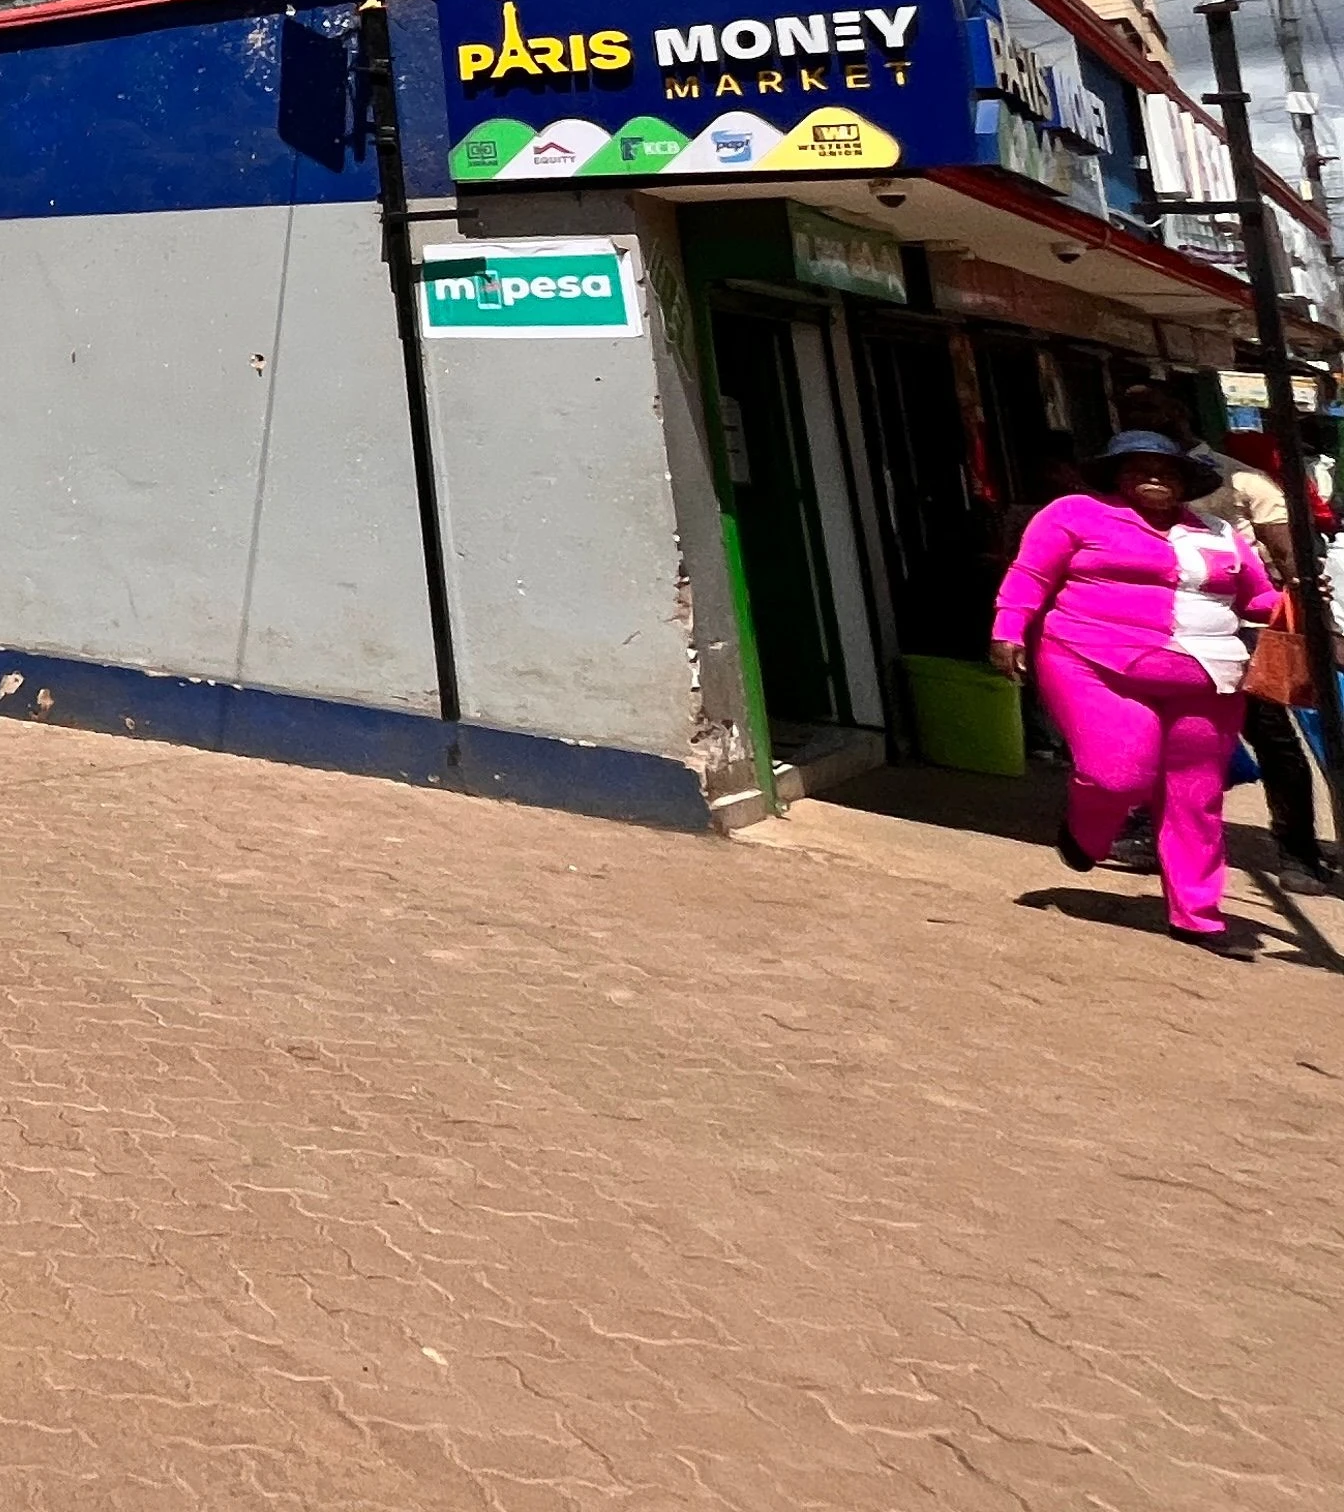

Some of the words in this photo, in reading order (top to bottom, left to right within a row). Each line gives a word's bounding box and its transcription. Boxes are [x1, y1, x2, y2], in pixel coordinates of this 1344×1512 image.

[458, 0, 631, 81] PARIS
[654, 5, 918, 67] MONEY
[665, 60, 916, 99] MARKET
[798, 142, 862, 151] WESTERN
[533, 155, 576, 166] EQUITY
